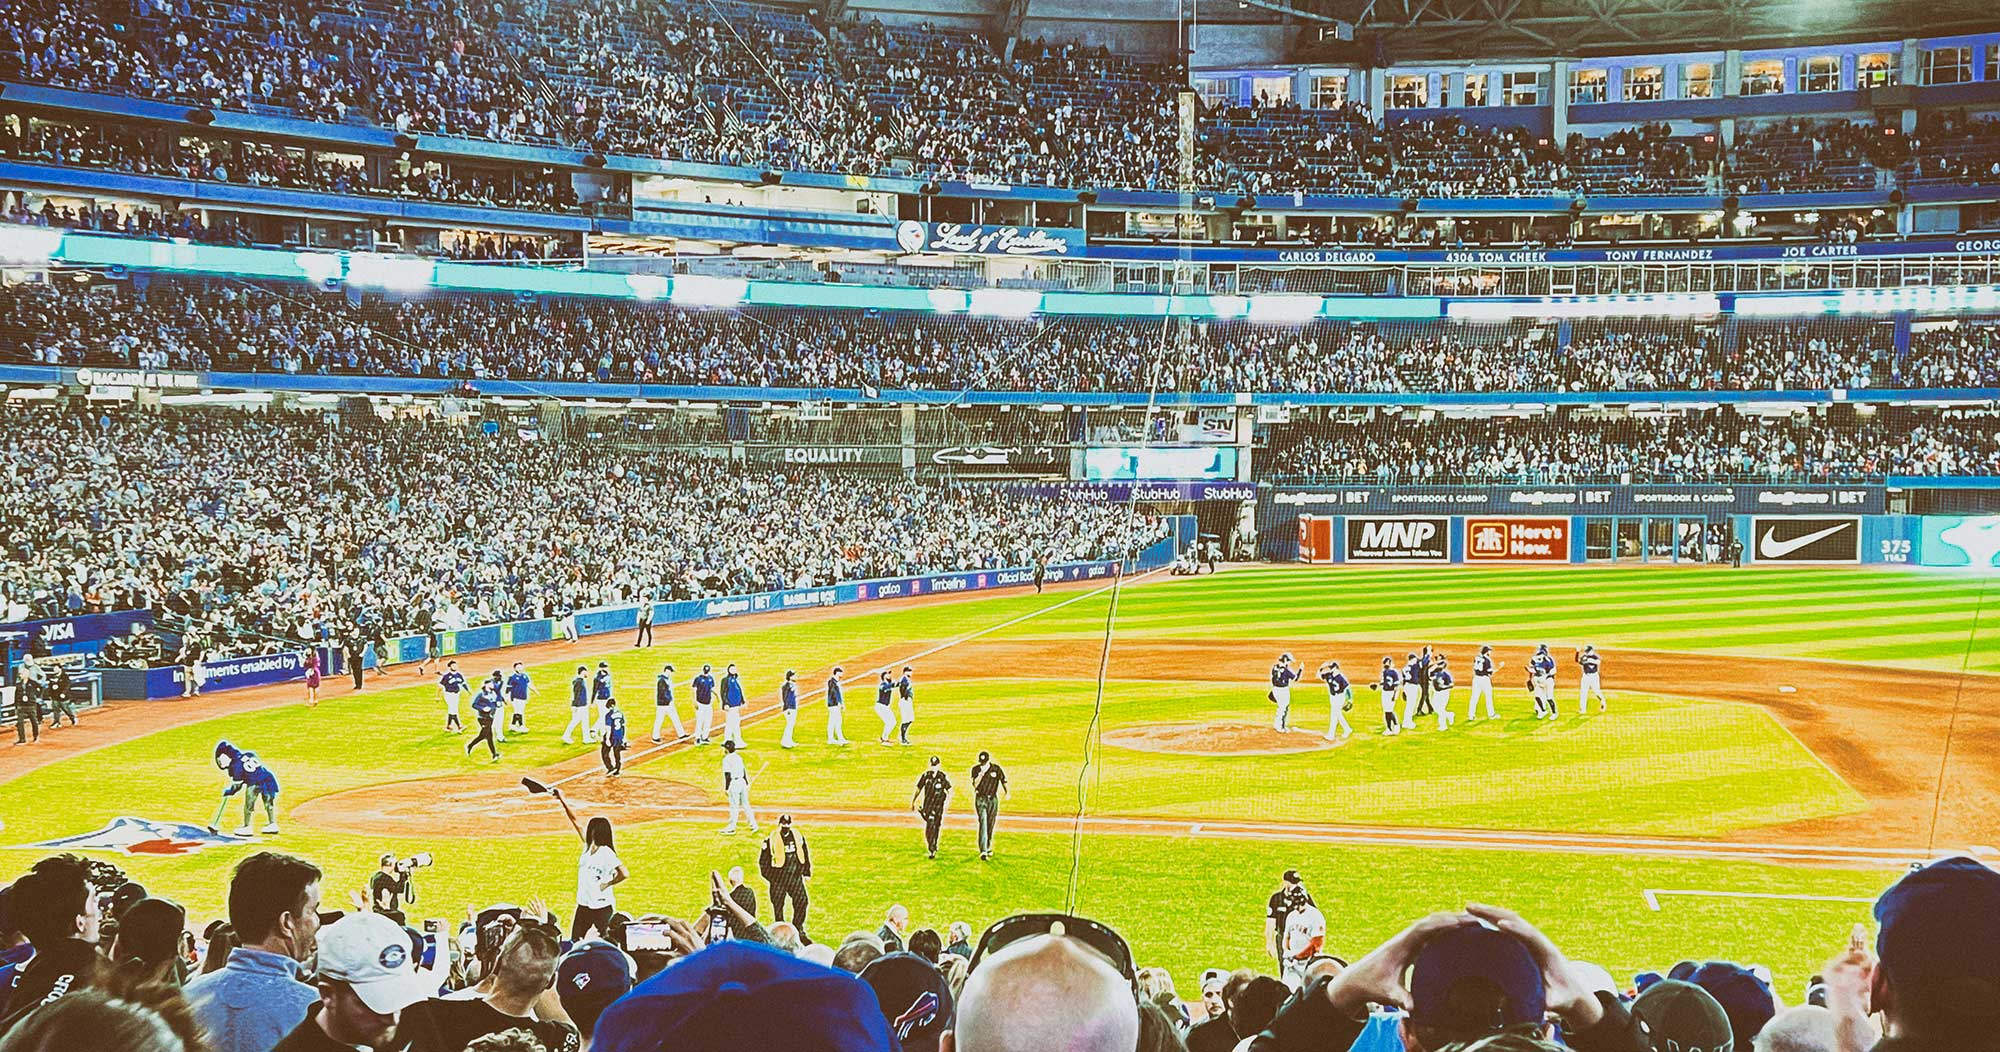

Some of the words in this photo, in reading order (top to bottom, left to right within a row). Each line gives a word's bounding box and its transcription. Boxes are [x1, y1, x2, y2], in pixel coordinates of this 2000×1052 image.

[1279, 251, 1321, 262] CARLOS
[1325, 251, 1376, 262] DELGADO
[1446, 252, 1474, 262] 4306
[1478, 252, 1504, 262] TOM
[1509, 252, 1547, 262] CHEEK
[1605, 250, 1639, 261] TONY
[1642, 249, 1713, 261] FERNANDEZ
[1782, 247, 1806, 257] JOE
[1812, 245, 1858, 257] CARTER
[784, 448, 865, 463] EQUALITY
[1133, 488, 1181, 501] StubHub
[1203, 486, 1254, 500] StubHub
[1346, 491, 1370, 503] BET
[1391, 494, 1447, 503] SPORTSBOOK
[1455, 494, 1489, 503] CASINO
[1585, 491, 1612, 503] BET
[1839, 491, 1867, 503] BET
[1360, 522, 1436, 548] MNP
[1510, 524, 1562, 540] Here's
[1880, 539, 1911, 554] 375
[42, 622, 76, 641] VISA
[240, 657, 282, 675] enabled
[283, 656, 297, 672] by
